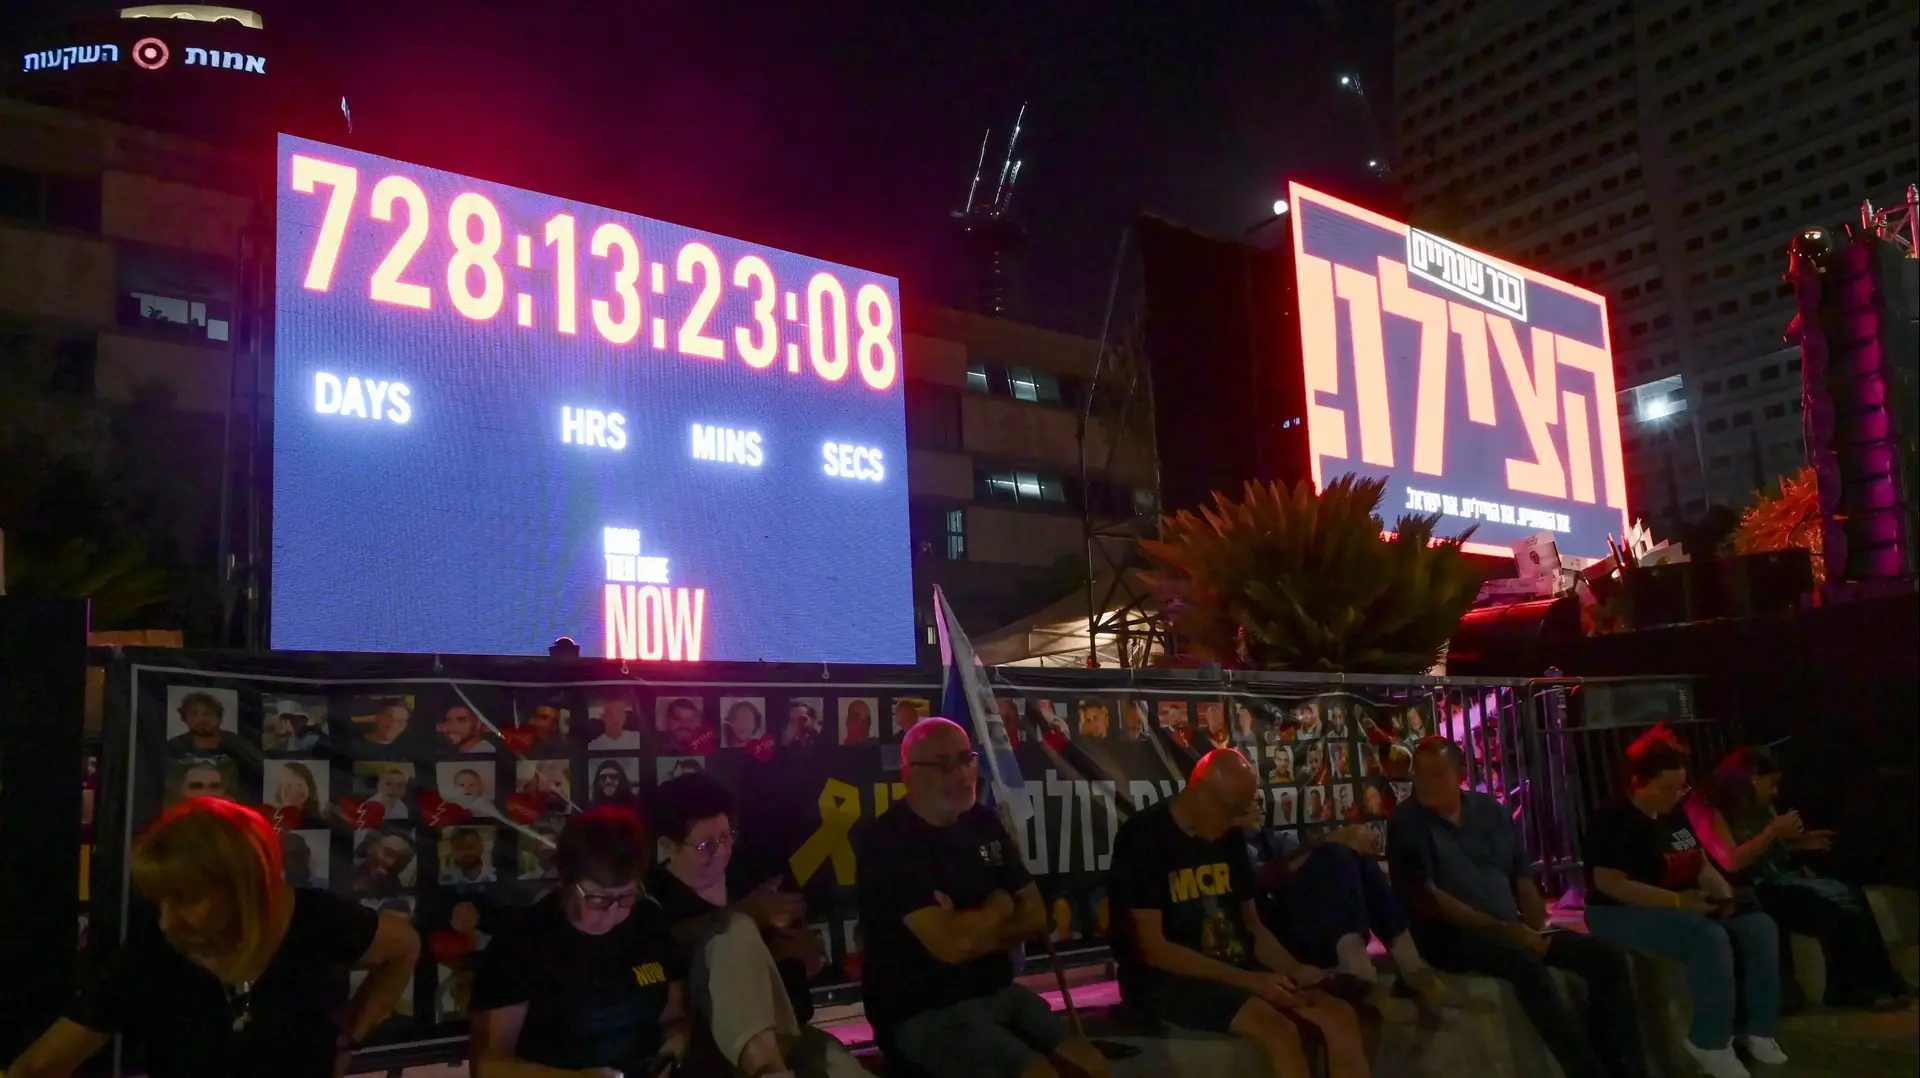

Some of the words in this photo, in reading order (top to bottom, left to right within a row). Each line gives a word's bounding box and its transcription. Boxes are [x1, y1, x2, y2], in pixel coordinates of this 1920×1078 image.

[23, 44, 119, 72] השקעות
[185, 46, 267, 75] אמות
[291, 154, 897, 391] 728:13:23:08
[1411, 230, 1485, 295] שנתיים
[1486, 265, 1521, 311] כבר
[314, 371, 411, 425] DAYS
[561, 405, 627, 451] HRS
[692, 423, 764, 467] MINS
[823, 442, 885, 482] SECS
[605, 583, 705, 661] NOW
[1168, 862, 1232, 903] MCR
